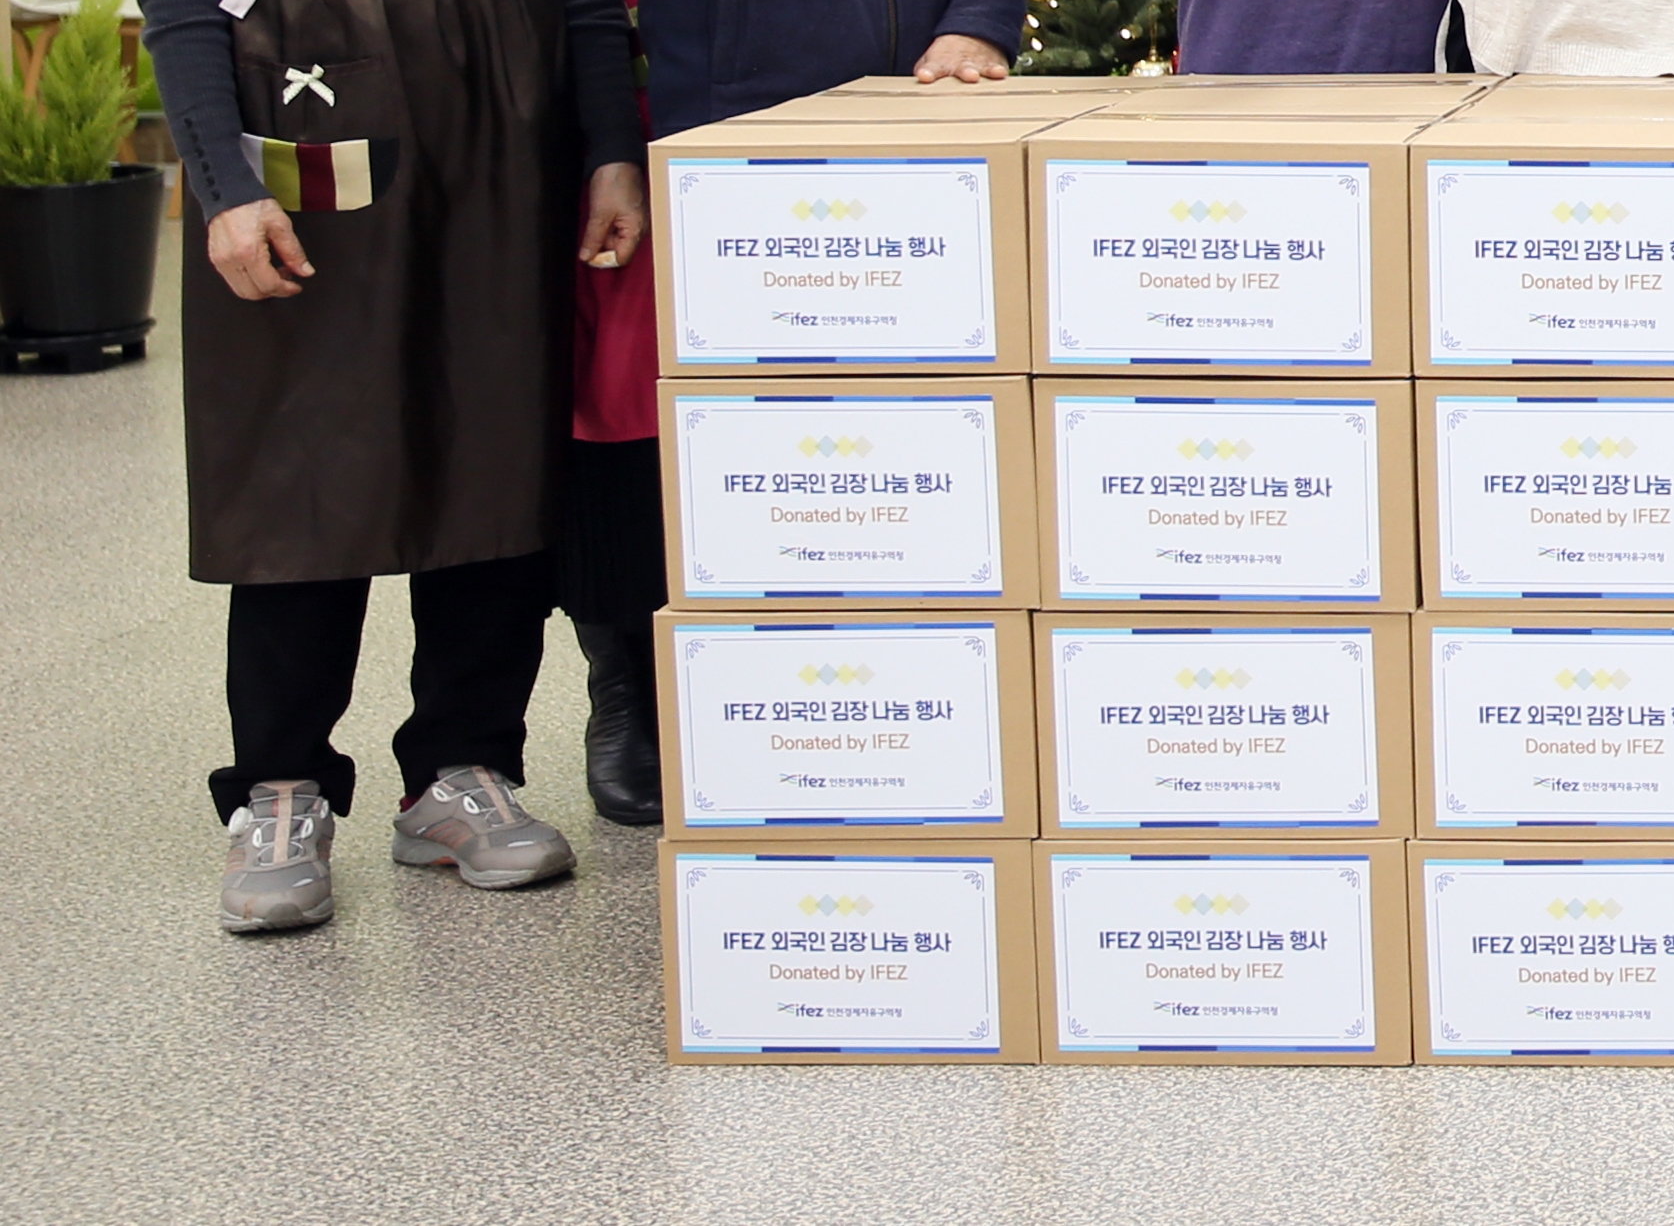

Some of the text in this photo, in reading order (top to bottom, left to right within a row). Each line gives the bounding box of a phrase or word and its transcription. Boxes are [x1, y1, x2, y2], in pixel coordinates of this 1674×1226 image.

[717, 237, 946, 258] IFEZ 외국인 김장 나눔 행사
[764, 271, 902, 290] Donated by IFEZ
[1102, 475, 1333, 498] IFEZ 외국인 김장 나눔 행사
[1148, 509, 1288, 529] Donated by IFEZ
[1479, 706, 1522, 724] IFEZ
[1527, 705, 1583, 726] 외국인
[1586, 706, 1624, 726] 김장
[1628, 706, 1666, 726] 나눔
[1525, 738, 1665, 757] Donated by IFEZ
[723, 931, 952, 952] IFEZ 외국인 김장 나눔 행사
[769, 964, 908, 983] Donated by IFEZ
